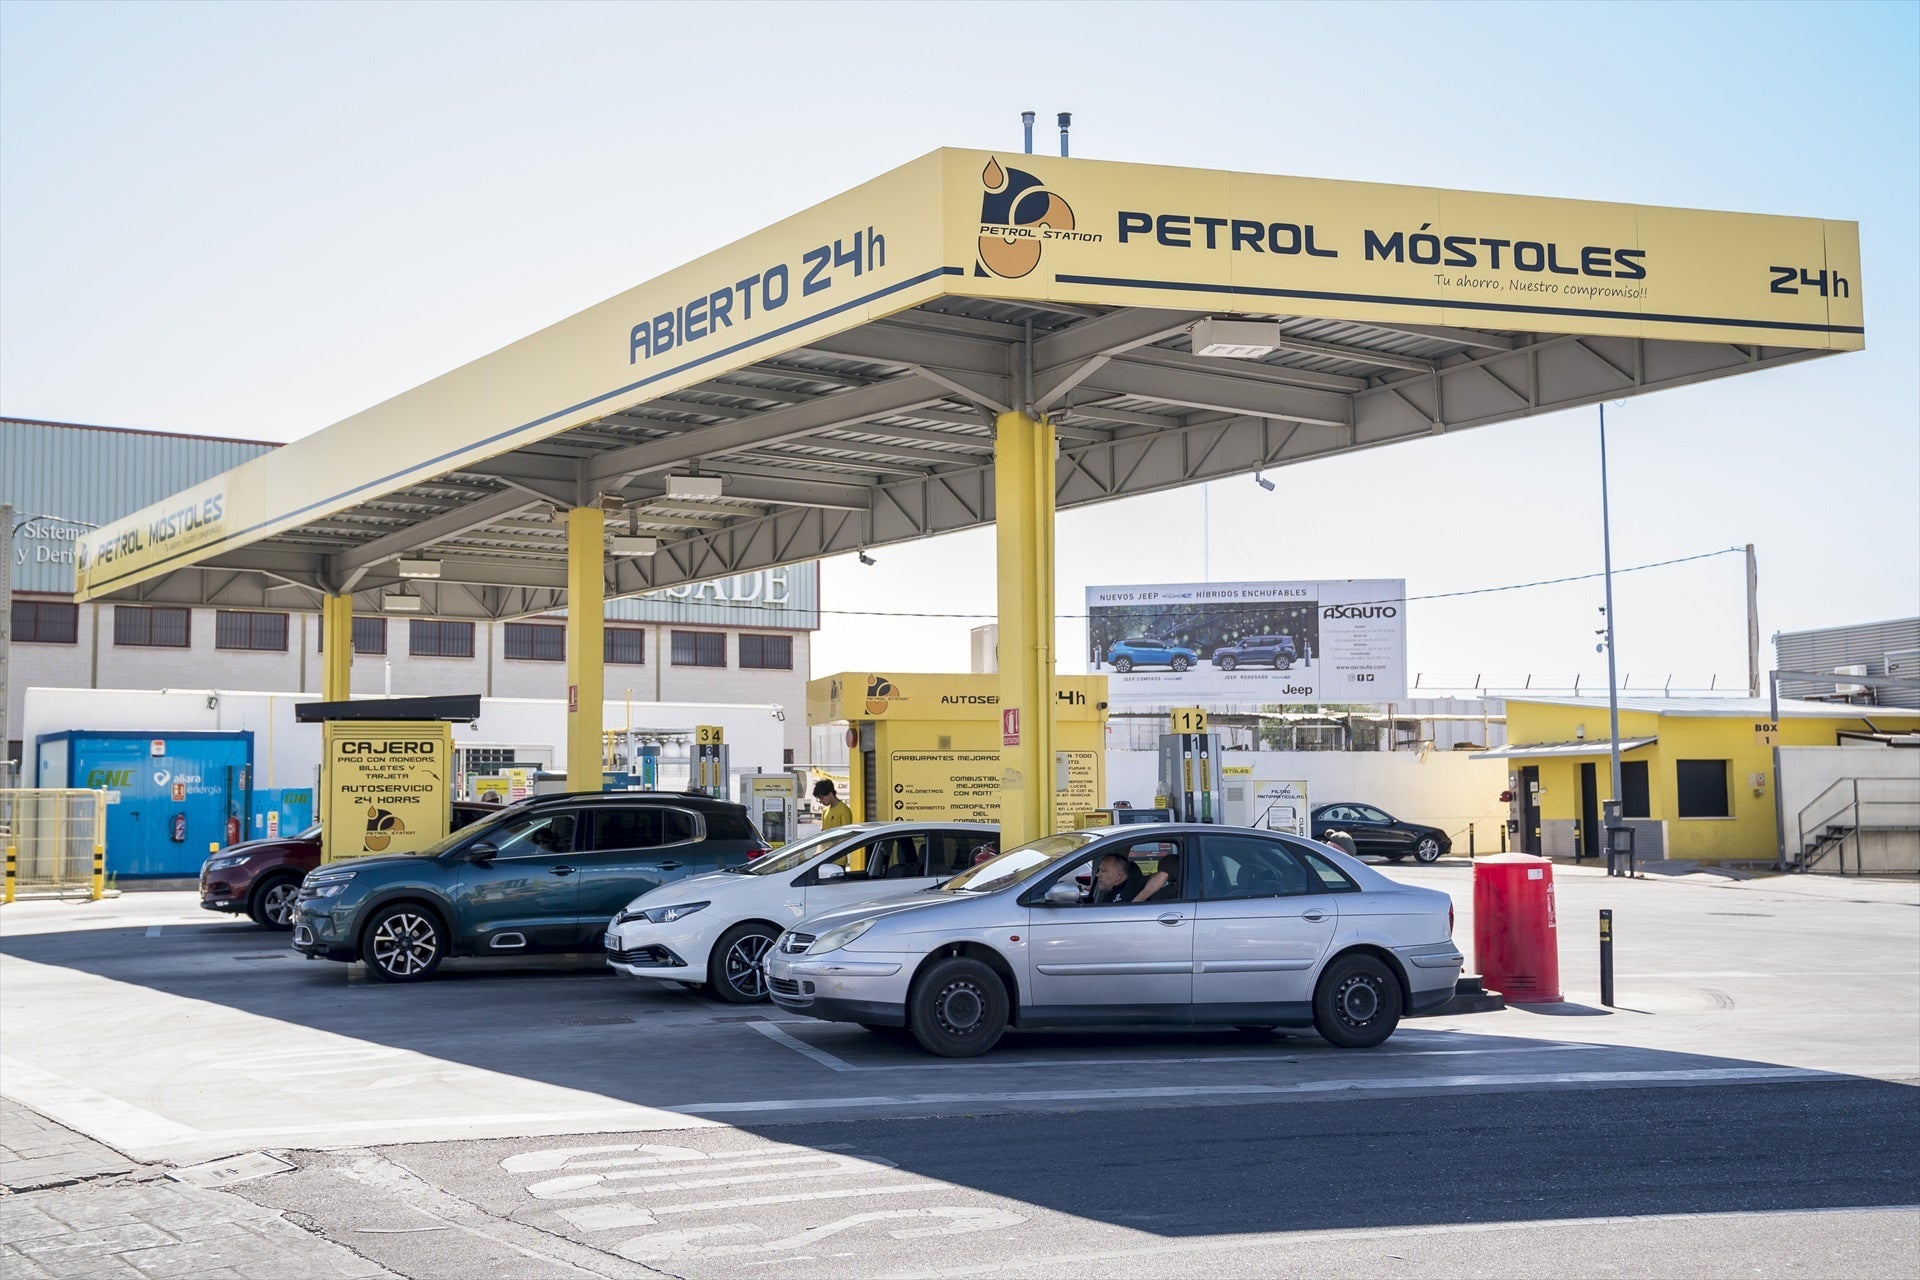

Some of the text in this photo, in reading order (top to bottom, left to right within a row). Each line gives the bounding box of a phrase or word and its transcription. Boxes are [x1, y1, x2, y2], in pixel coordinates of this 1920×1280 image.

[980, 225, 1103, 243] PETROL STATION
[1117, 210, 1849, 299] PETROL MÓSTOLES 24h
[1434, 273, 1648, 300] Tu ahorro, Nuestro compromiso!!
[630, 225, 885, 365] ABIERTO 24h
[23, 521, 92, 541] Sistema
[97, 528, 144, 567] PETROL
[148, 493, 223, 547] MÓSTOLES
[16, 548, 29, 565] y
[1100, 593, 1134, 601] NUEVOS
[1137, 592, 1159, 600] JEEP
[1196, 588, 1239, 598] HÍBRIDOS
[1242, 588, 1307, 598] ENCHUFABLES
[1323, 605, 1397, 619] ASCAUTO
[1282, 684, 1313, 696] Jeep
[1056, 690, 1086, 705] 4h
[1172, 713, 1177, 730] 1
[1182, 712, 1190, 729] 1
[1195, 713, 1203, 730] 2
[1754, 723, 1778, 732] BOX
[701, 728, 709, 741] 3
[712, 730, 721, 742] 4
[1764, 736, 1770, 744] 1
[341, 741, 434, 754] CAJERO
[1192, 736, 1199, 750] 1
[706, 746, 713, 756] 3
[87, 769, 136, 788] GNC
[173, 772, 202, 783] aliara
[341, 784, 433, 793] AUTOSERVICIO
[284, 792, 309, 804] GNC
[354, 796, 421, 804] 24 HORAS
